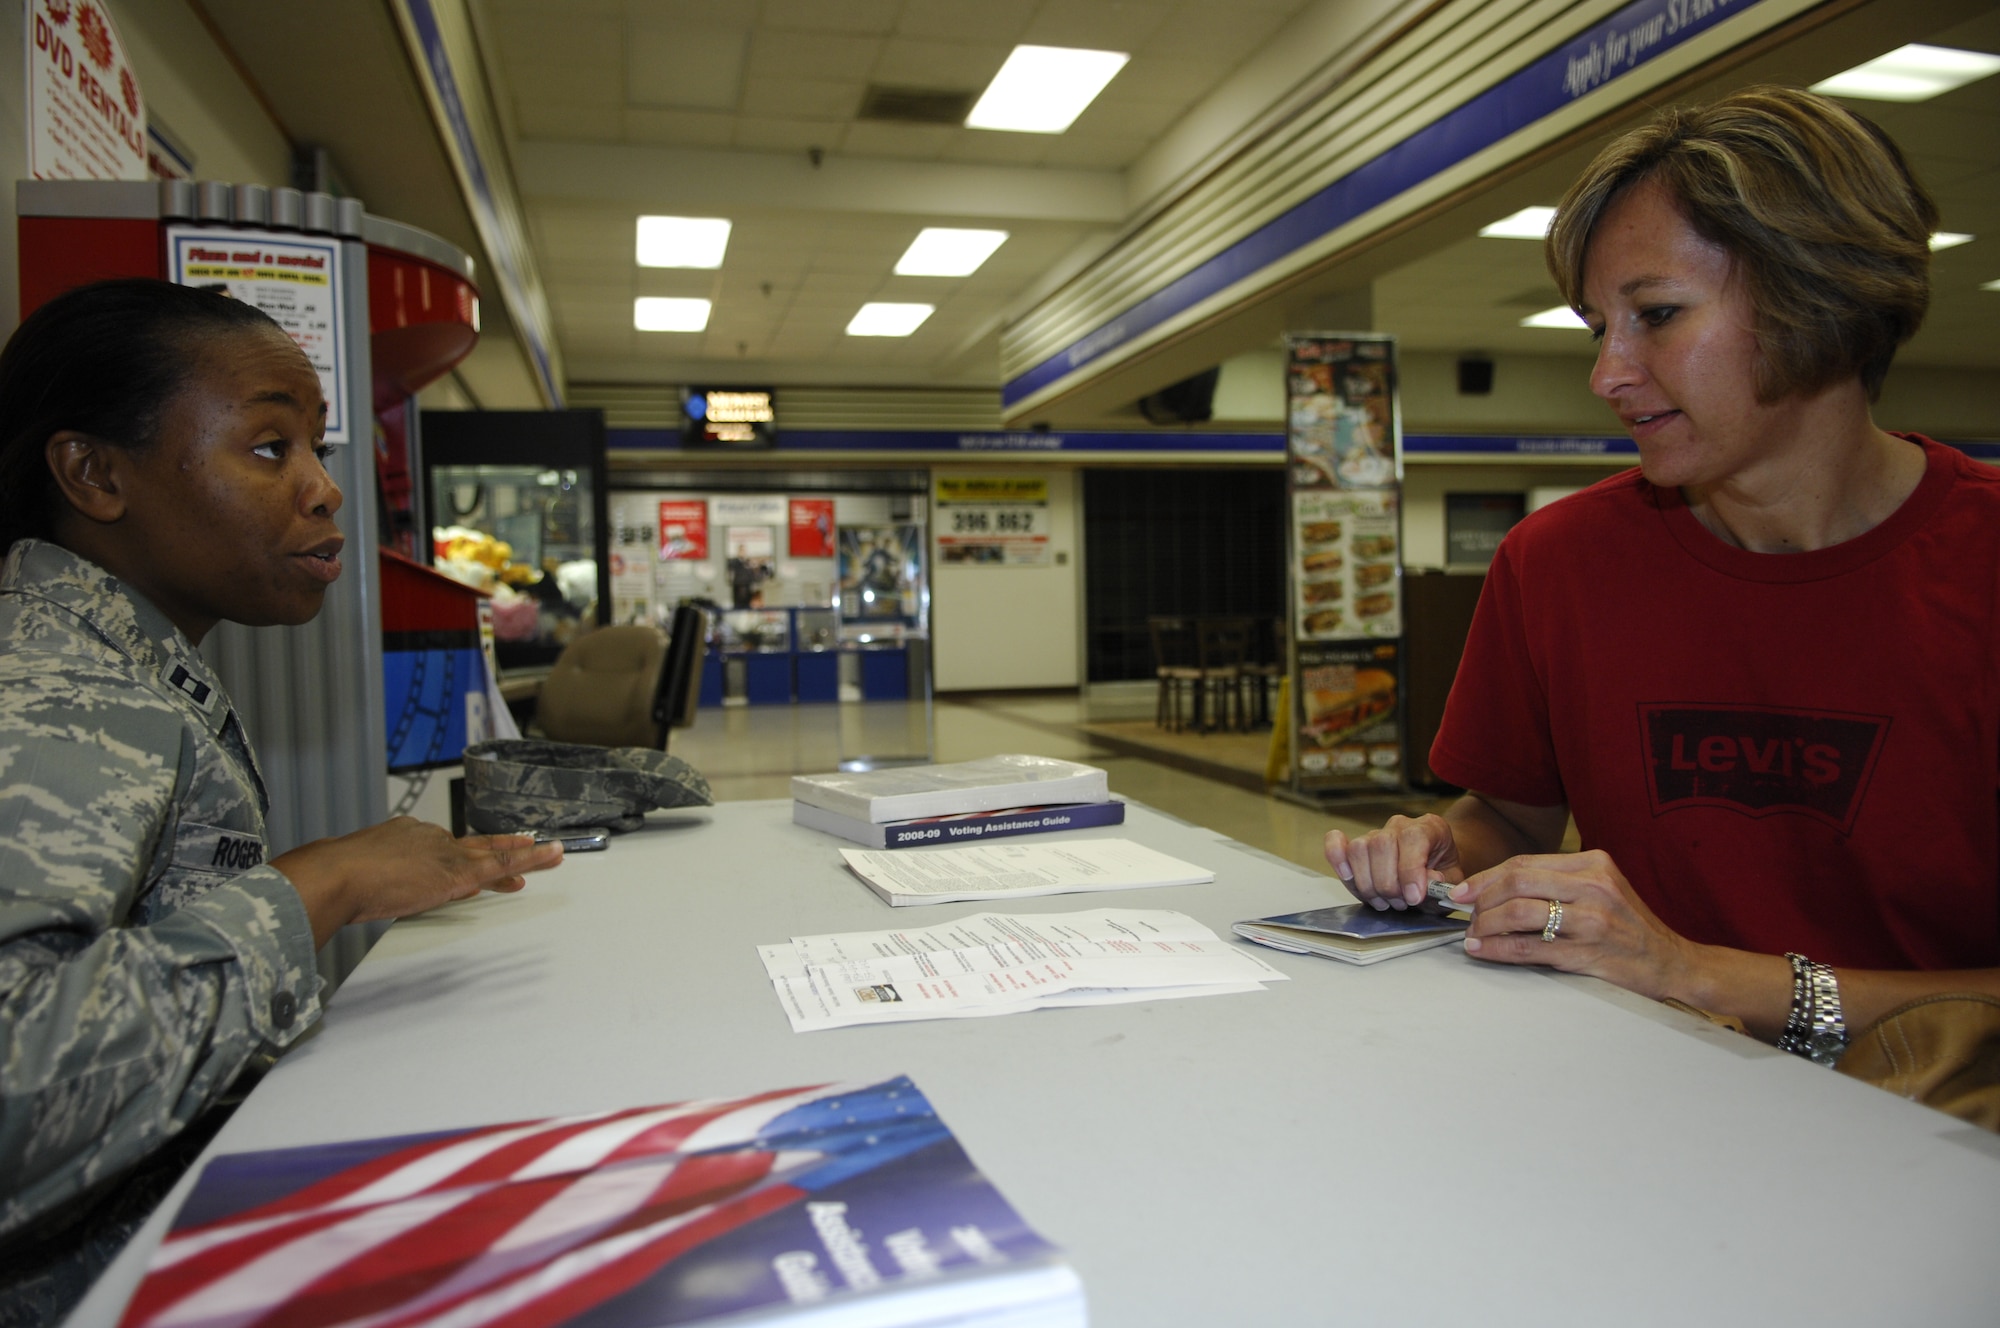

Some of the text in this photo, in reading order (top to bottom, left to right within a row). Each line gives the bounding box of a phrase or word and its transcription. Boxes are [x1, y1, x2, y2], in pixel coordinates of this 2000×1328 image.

[1562, 41, 1603, 97] Apply
[1603, 29, 1628, 82] for
[1628, 12, 1666, 67] your
[36, 14, 73, 78] DVD
[78, 63, 144, 160] RENTALS
[232, 250, 260, 263] and
[264, 255, 273, 264] a
[1670, 734, 1842, 785] Levi's
[897, 815, 1071, 842] 2008-09 Voting Assistance Guide
